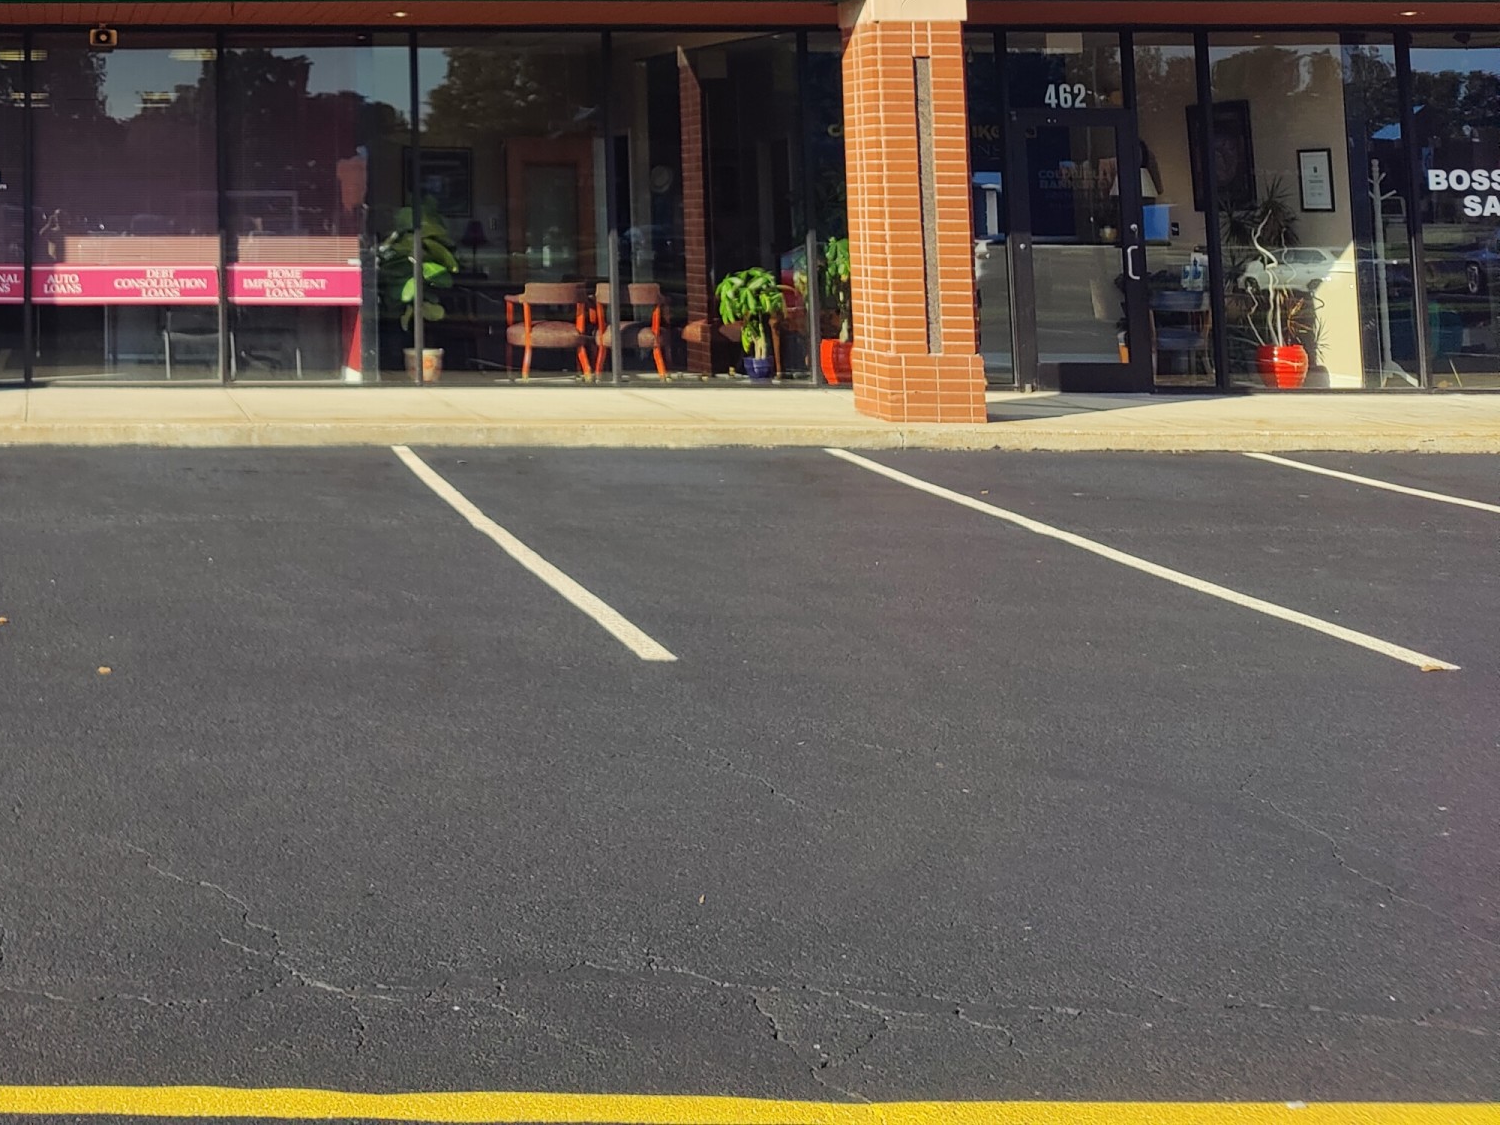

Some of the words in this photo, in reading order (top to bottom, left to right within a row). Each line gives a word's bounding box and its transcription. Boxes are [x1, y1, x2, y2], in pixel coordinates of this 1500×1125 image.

[1044, 83, 1087, 109] 462
[47, 273, 79, 283] AUTO
[145, 268, 176, 278] DEBT
[266, 268, 303, 278] HOME
[44, 283, 82, 294] LOANS
[113, 278, 207, 289] CONSOLIDATION
[242, 278, 328, 290] IMPROVEMENT
[141, 288, 180, 297] LOANS
[265, 288, 305, 298] LOANS
